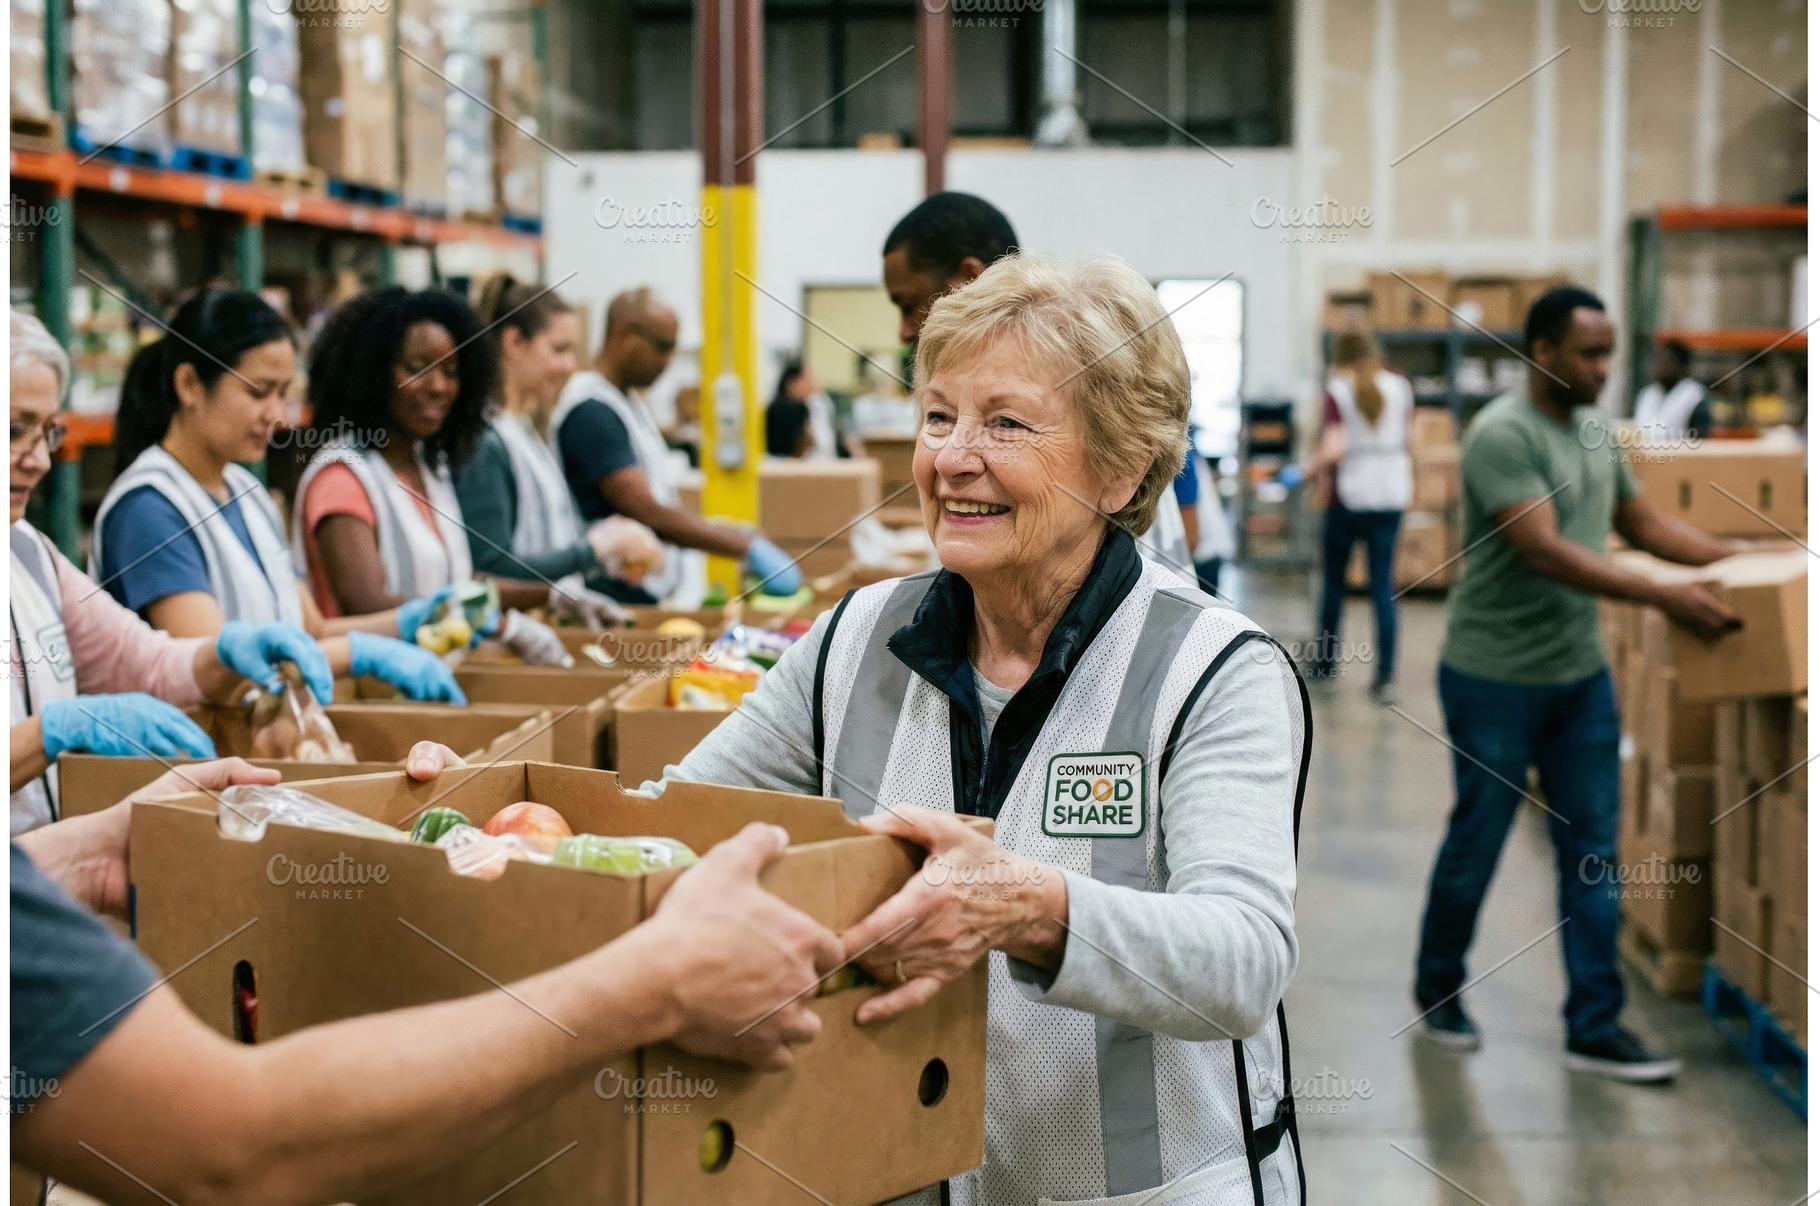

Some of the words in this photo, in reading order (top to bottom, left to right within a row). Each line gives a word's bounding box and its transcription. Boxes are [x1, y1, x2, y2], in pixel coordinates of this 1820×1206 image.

[1057, 763, 1135, 776] COMMUNITY
[1054, 778, 1134, 802] FOOD
[1052, 804, 1133, 825] SHARE
